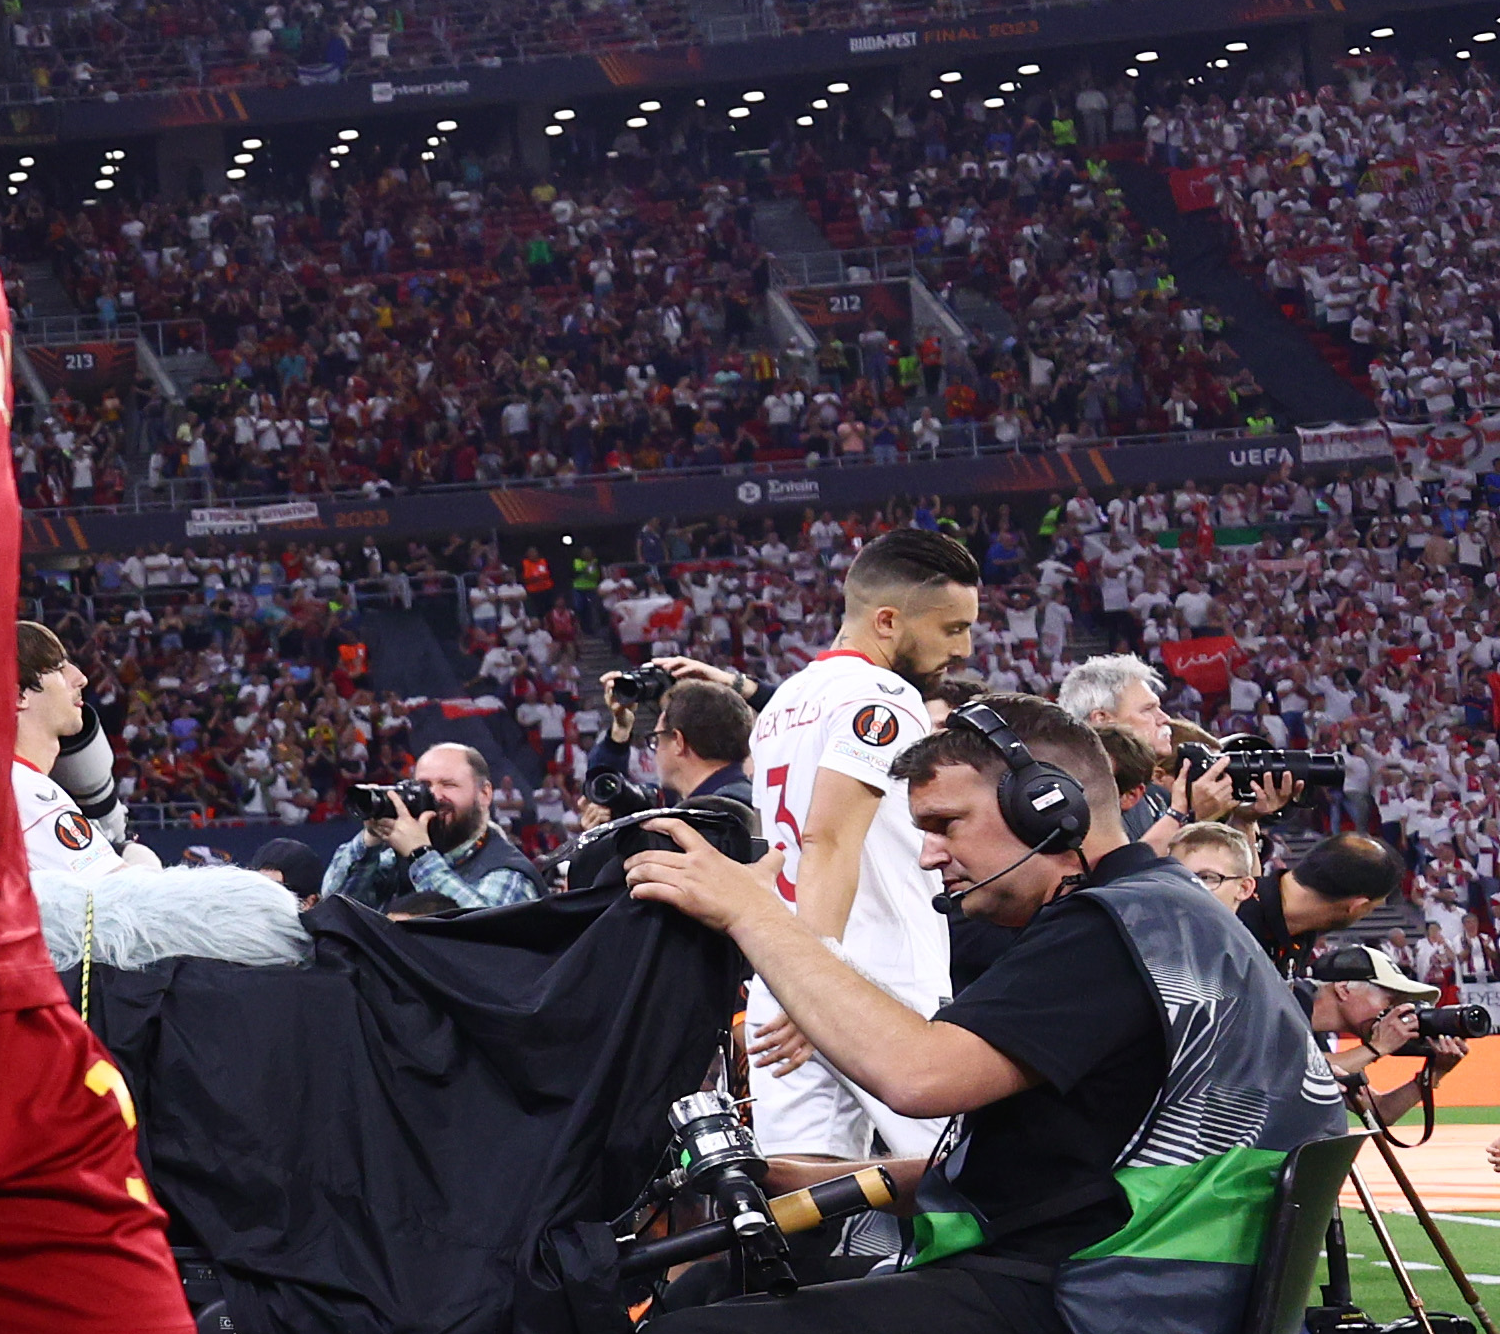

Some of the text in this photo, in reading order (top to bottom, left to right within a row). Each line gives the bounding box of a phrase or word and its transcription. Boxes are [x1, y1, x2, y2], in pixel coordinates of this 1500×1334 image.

[922, 25, 981, 45] FINAL
[986, 19, 1041, 40] 2023
[828, 294, 862, 313] 212
[64, 353, 95, 371] 213
[1229, 447, 1296, 468] UEFA
[333, 509, 390, 528] 2023
